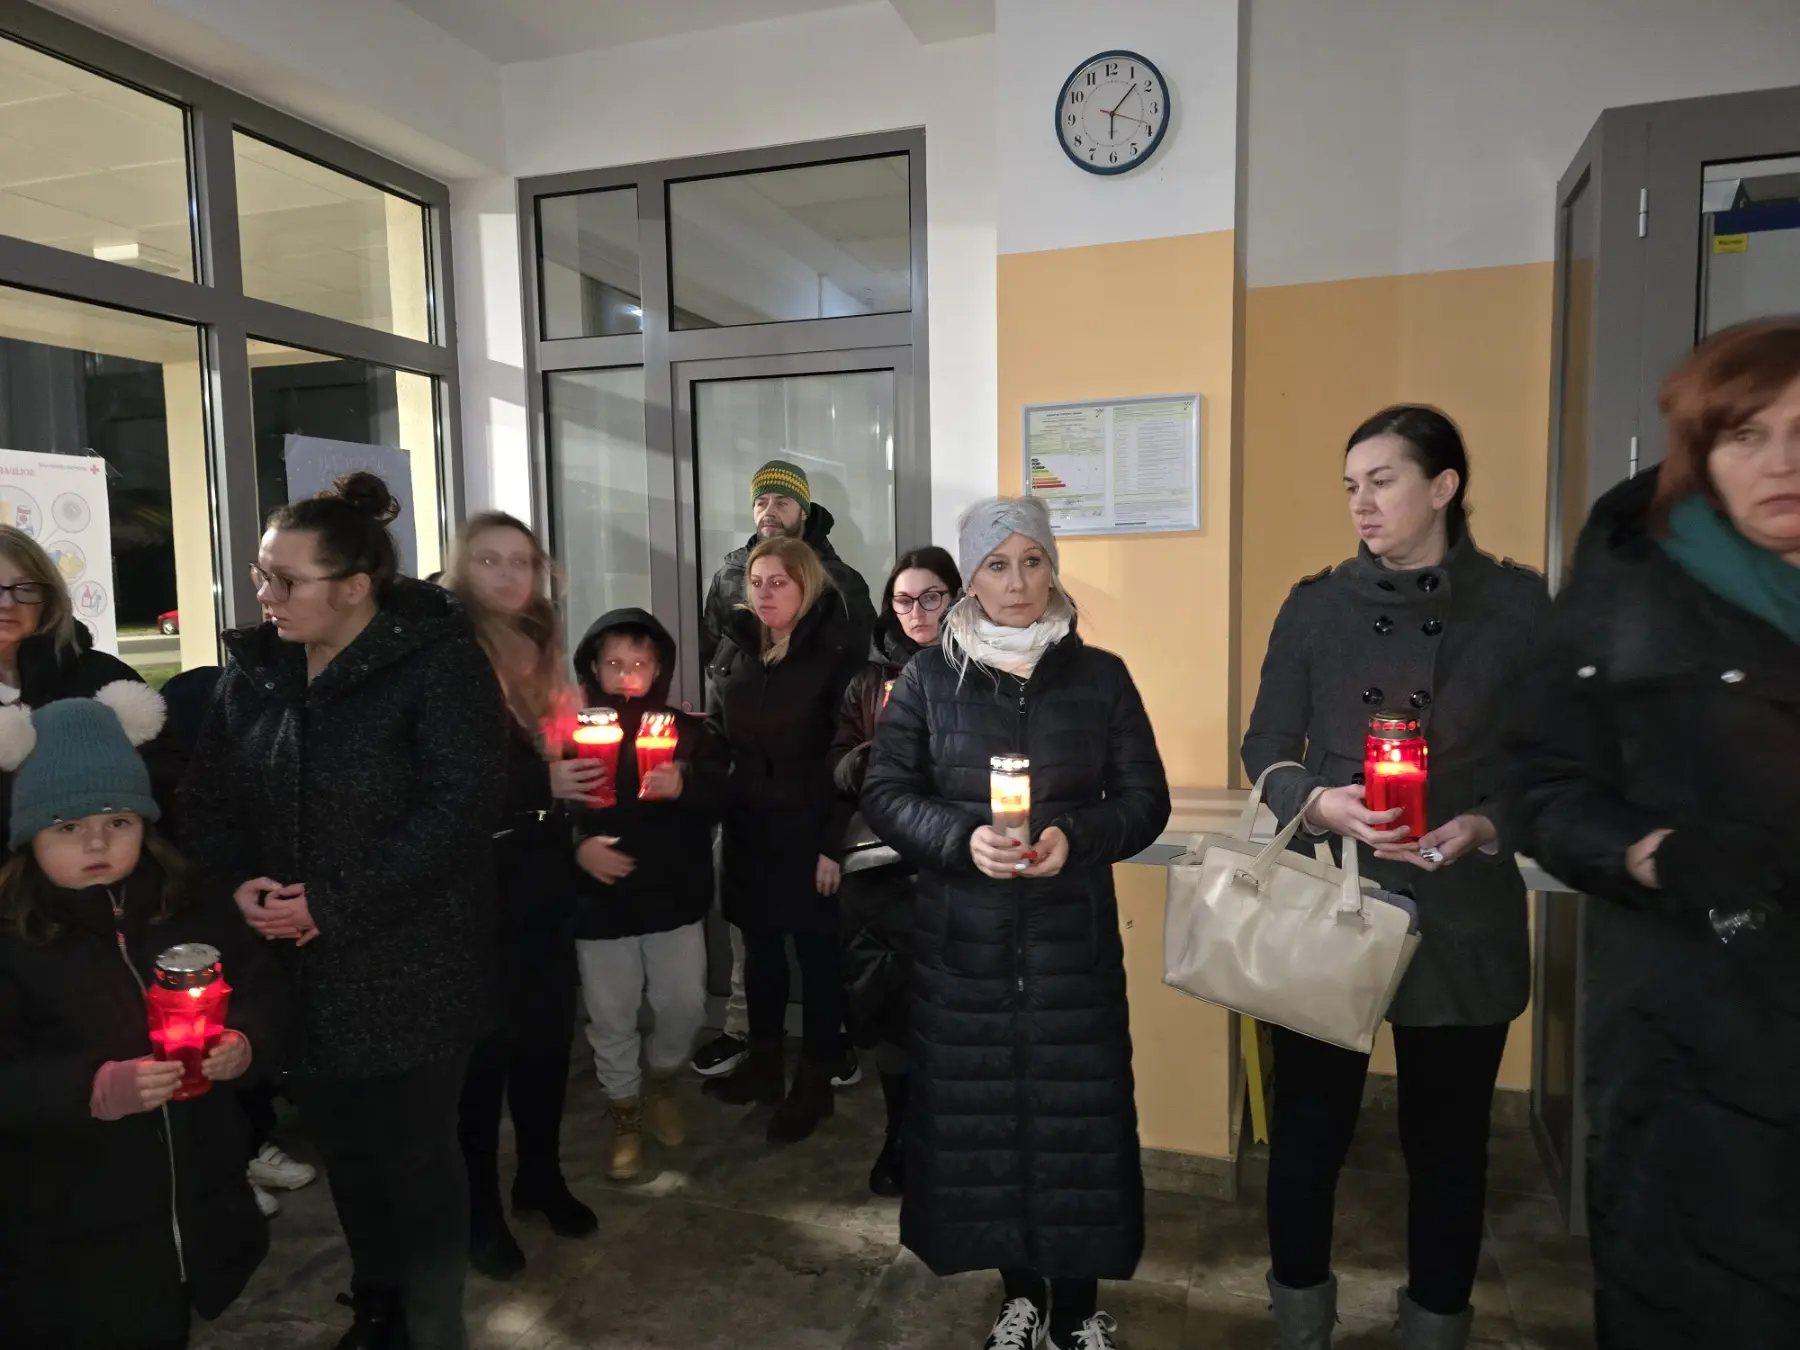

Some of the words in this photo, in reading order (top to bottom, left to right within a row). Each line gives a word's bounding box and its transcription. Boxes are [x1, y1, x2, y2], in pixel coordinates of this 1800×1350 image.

[1105, 63, 1118, 77] 12
[1130, 67, 1135, 79] 1
[1087, 73, 1096, 86] 11
[1144, 80, 1152, 93] 2
[1071, 91, 1084, 104] 10
[1150, 102, 1158, 115] 3
[1067, 114, 1076, 126] 9
[1144, 125, 1152, 137] 4
[1073, 134, 1082, 147] 8
[1088, 148, 1096, 161] 7
[1129, 142, 1138, 155] 5
[1109, 151, 1118, 164] 6
